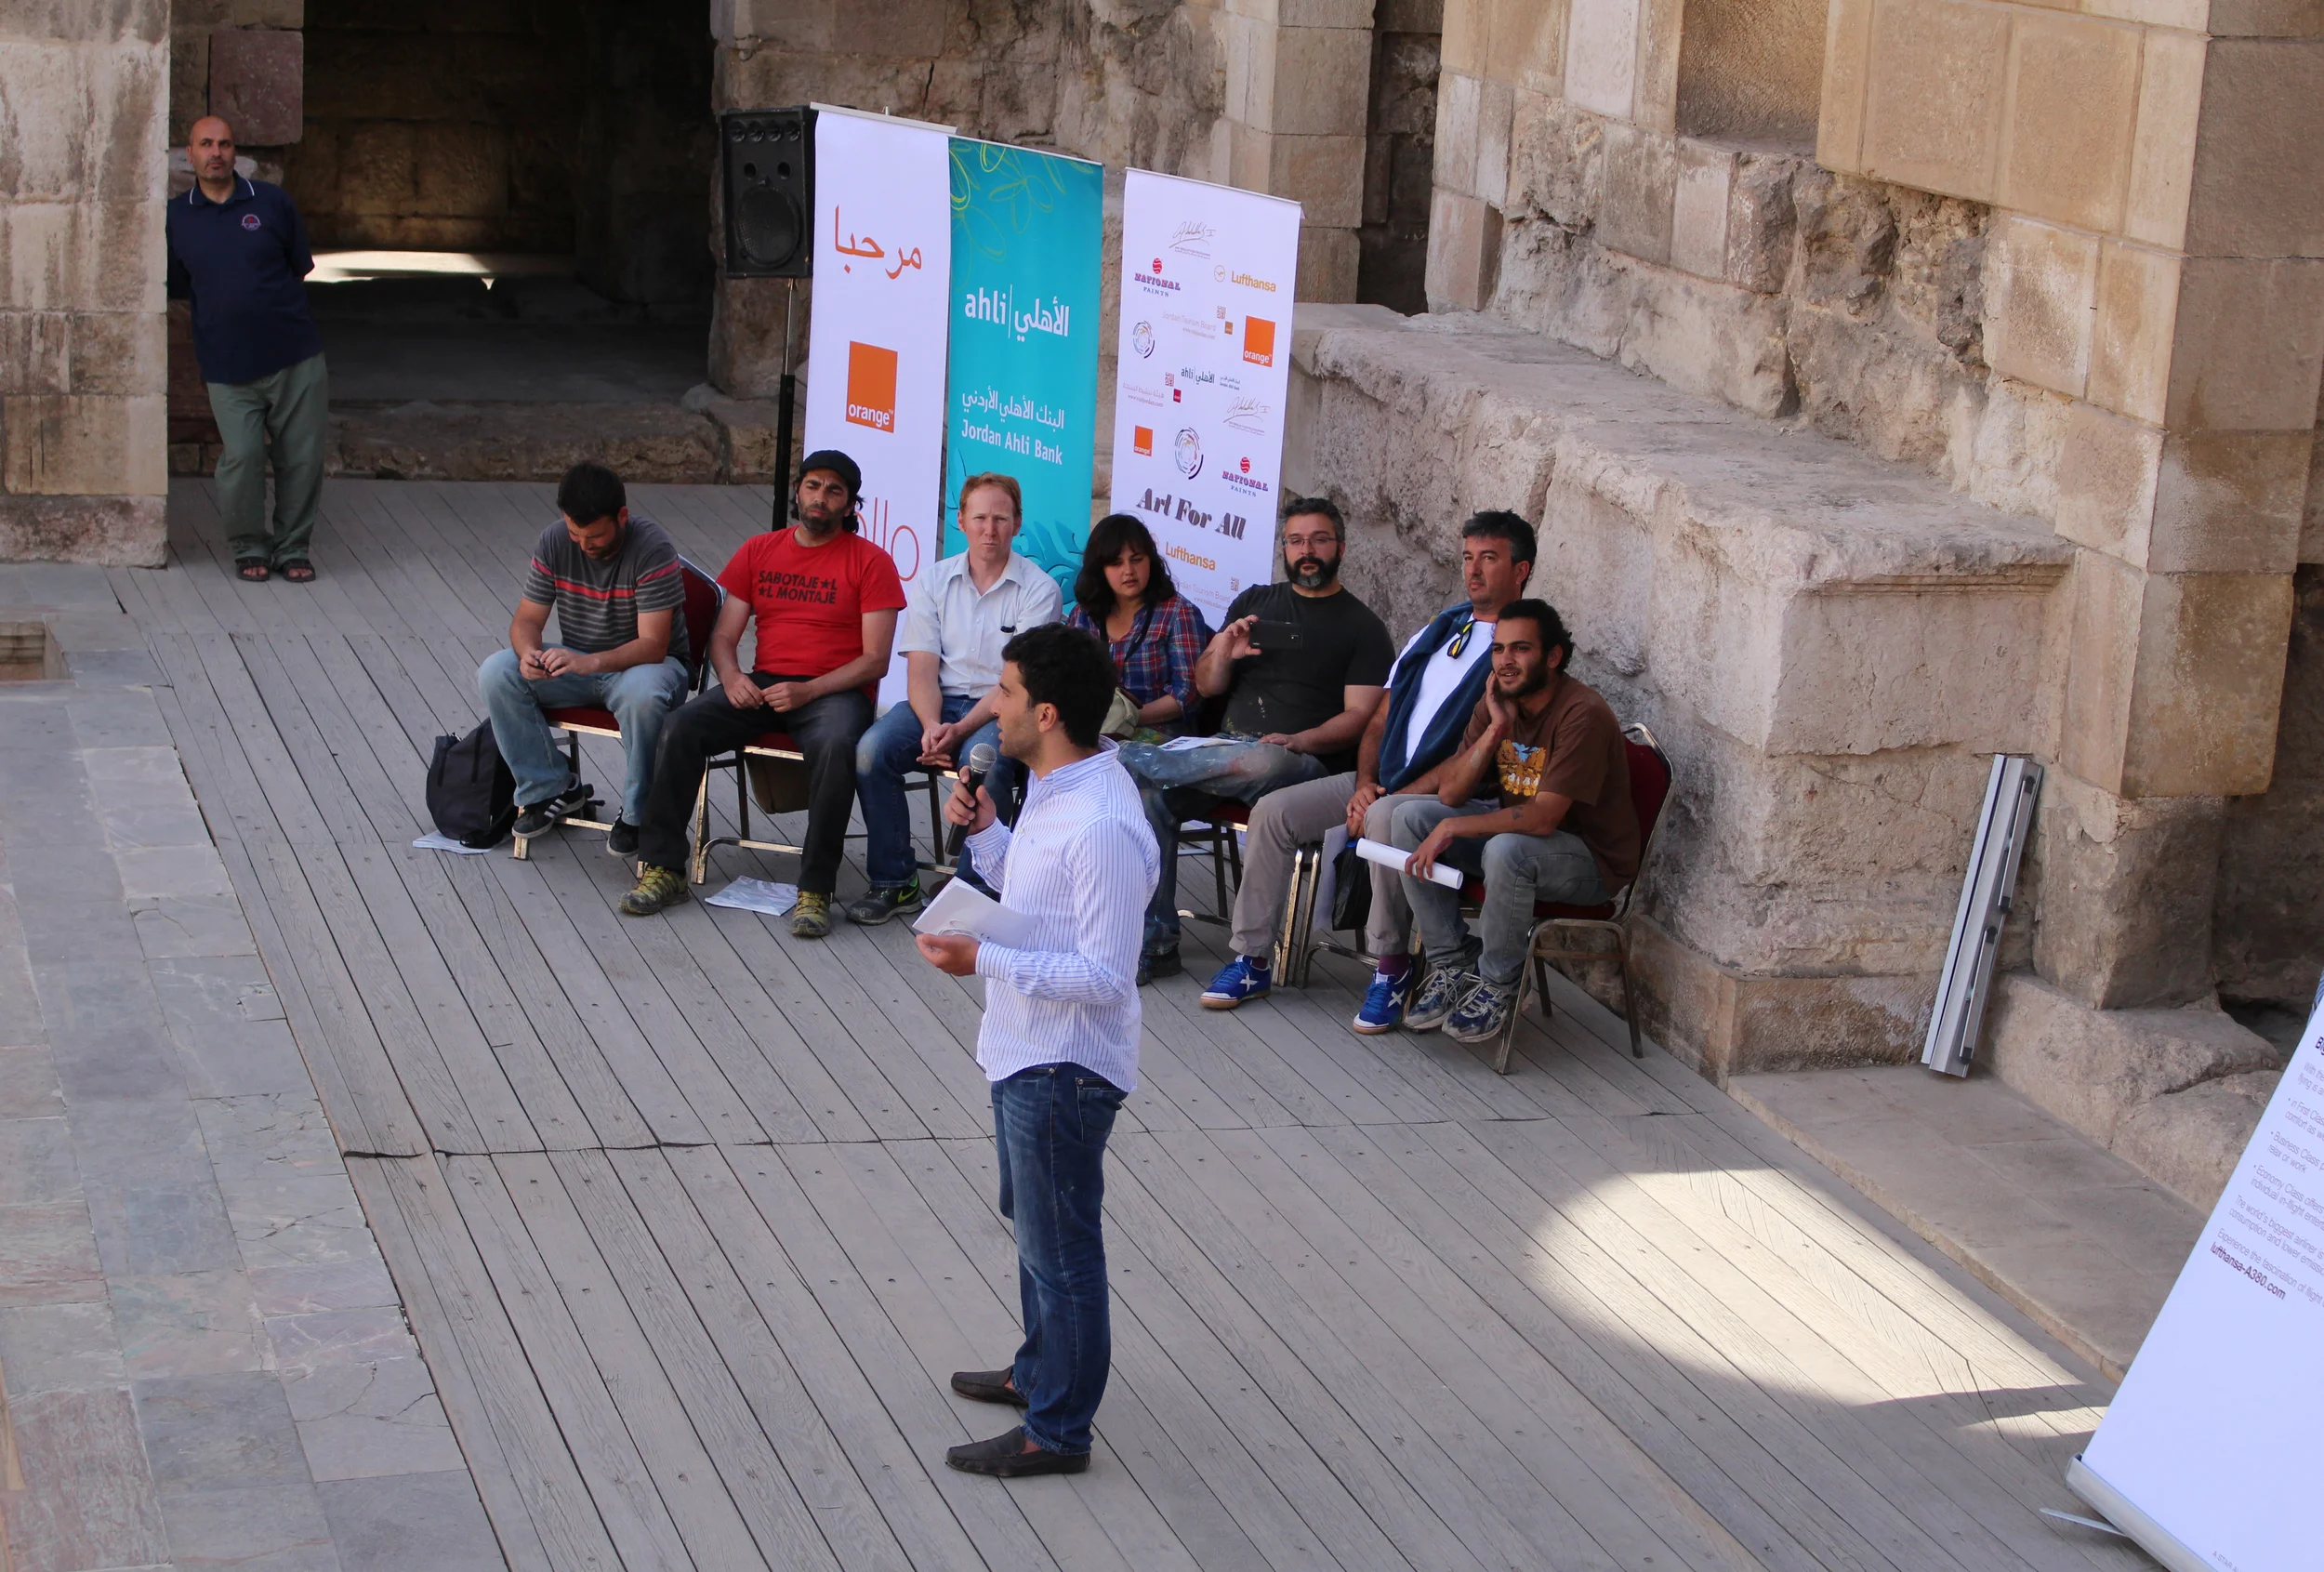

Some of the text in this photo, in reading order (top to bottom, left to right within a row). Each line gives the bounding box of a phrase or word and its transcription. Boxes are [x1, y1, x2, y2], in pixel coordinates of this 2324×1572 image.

[835, 204, 922, 280] مرحبا
[1134, 272, 1181, 291] NATIONAL
[1143, 286, 1169, 297] PAINTS
[1231, 271, 1276, 292] Lufthansa
[965, 287, 1070, 342] ahli الأهلي
[1244, 350, 1270, 363] orange
[1181, 367, 1193, 379] ahli
[849, 403, 890, 428] orange
[999, 394, 1034, 423] الأهلي
[1036, 404, 1064, 432] البنك
[961, 418, 1063, 465] Jordan Ahli Bank
[1222, 470, 1268, 492] NATIONAL
[1231, 485, 1256, 497] PAINTS
[1136, 488, 1247, 540] Art For All
[1165, 542, 1216, 571] Lufthansa
[759, 570, 819, 588] SABOTAJE
[775, 587, 837, 604] MONTAJE
[2273, 1130, 2300, 1155] Business
[2300, 1148, 2320, 1167] Class
[2290, 1158, 2307, 1173] work
[2256, 1164, 2284, 1190] Economy
[2285, 1182, 2304, 1202] Class
[2236, 1194, 2246, 1209] The
[2268, 1217, 2294, 1240] biggest
[2228, 1208, 2266, 1237] consumption
[2266, 1233, 2282, 1247] and
[2281, 1240, 2301, 1259] lower
[2210, 1241, 2286, 1300] lufthansa-A380.com
[2217, 1227, 2250, 1256] Experience
[2250, 1250, 2262, 1264] the
[2262, 1258, 2297, 1288] fascination
